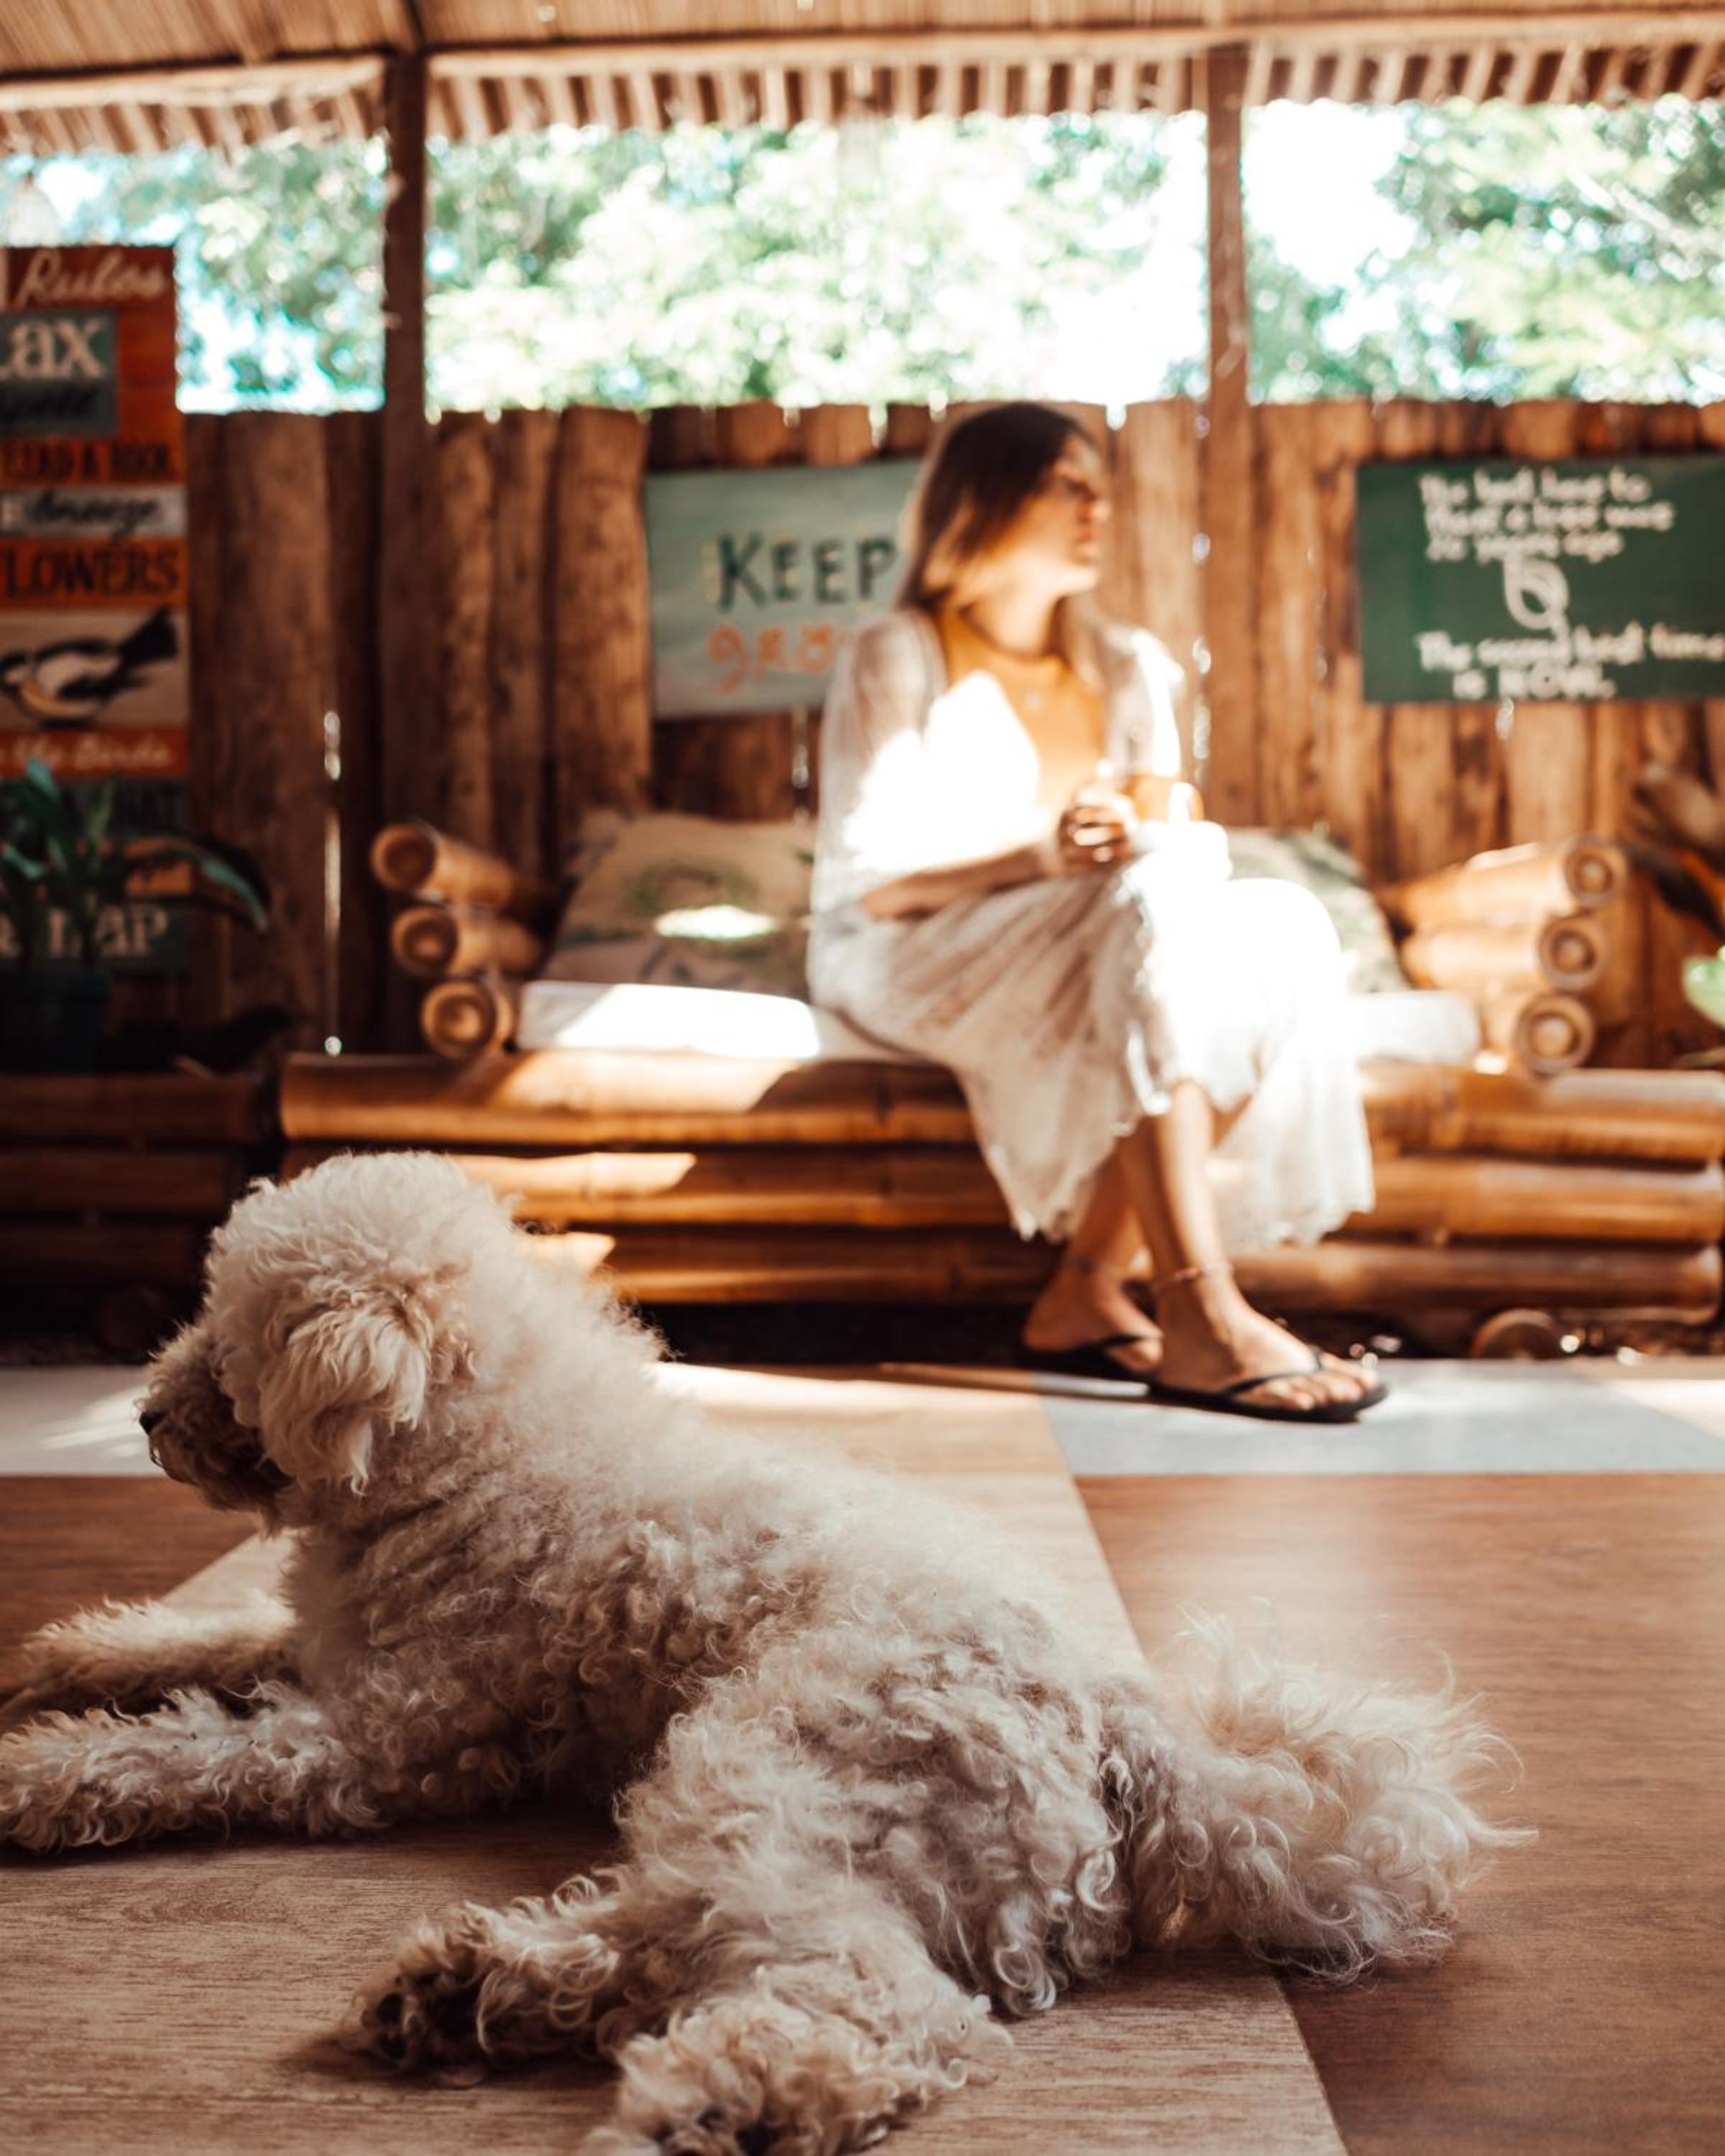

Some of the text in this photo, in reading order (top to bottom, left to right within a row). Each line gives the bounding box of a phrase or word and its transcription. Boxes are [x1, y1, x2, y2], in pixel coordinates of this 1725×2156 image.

[20, 249, 168, 308] Rules
[0, 321, 102, 379] ax
[1419, 466, 1651, 503] The best time to
[1533, 499, 1599, 530] tree
[0, 548, 181, 601] LOWERS
[719, 530, 898, 612] KEEP
[1417, 632, 1473, 672] The
[1574, 624, 1644, 665] best
